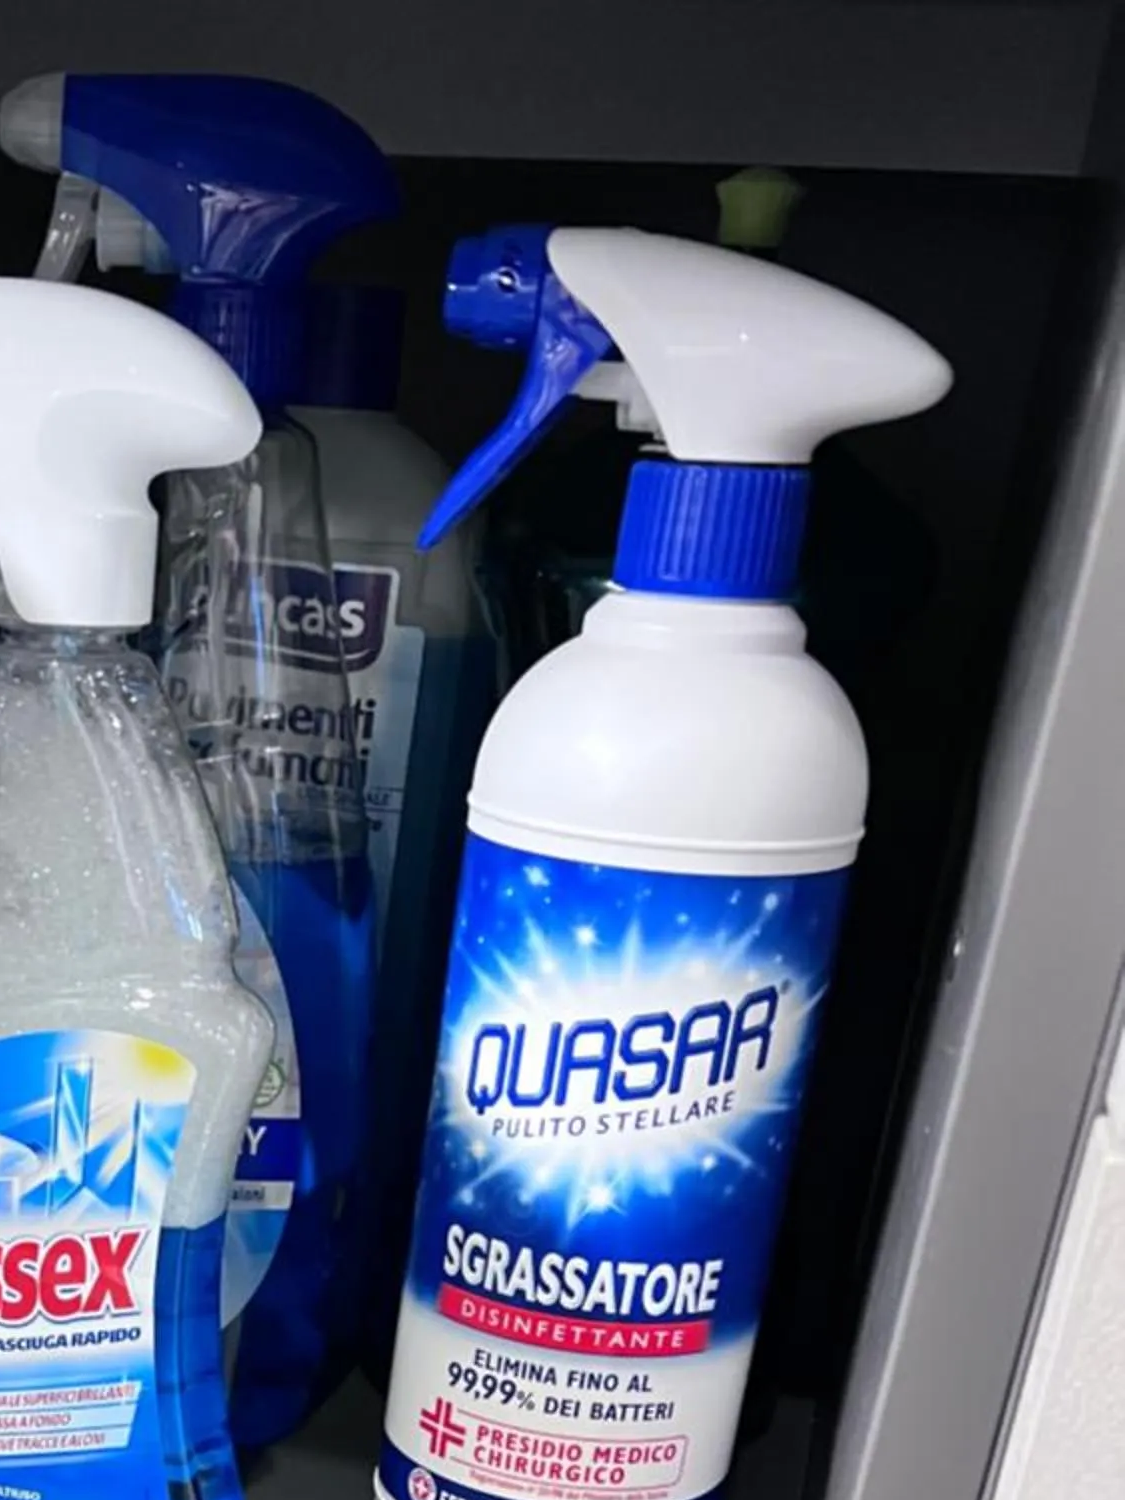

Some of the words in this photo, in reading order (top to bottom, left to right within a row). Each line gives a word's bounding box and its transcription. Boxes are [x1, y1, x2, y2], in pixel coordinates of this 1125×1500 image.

[466, 984, 778, 1116] QUASAR
[491, 1114, 586, 1139] PULITO
[595, 1091, 735, 1136] STELLARE
[443, 1222, 723, 1317] SGRASSATORE
[70, 1326, 142, 1347] RAPIDO
[460, 1299, 685, 1350] DISINFETTANTE
[446, 1360, 536, 1412] 99,99%
[543, 1396, 580, 1419] DEI
[590, 1401, 674, 1423] BATTERI
[473, 1347, 558, 1386] ELIMINA
[566, 1368, 619, 1393] FINO
[626, 1374, 653, 1394] AL
[472, 1445, 625, 1486] CHIRURGICO
[476, 1424, 583, 1462] PRESIDIO
[592, 1442, 677, 1466] MEDICO
